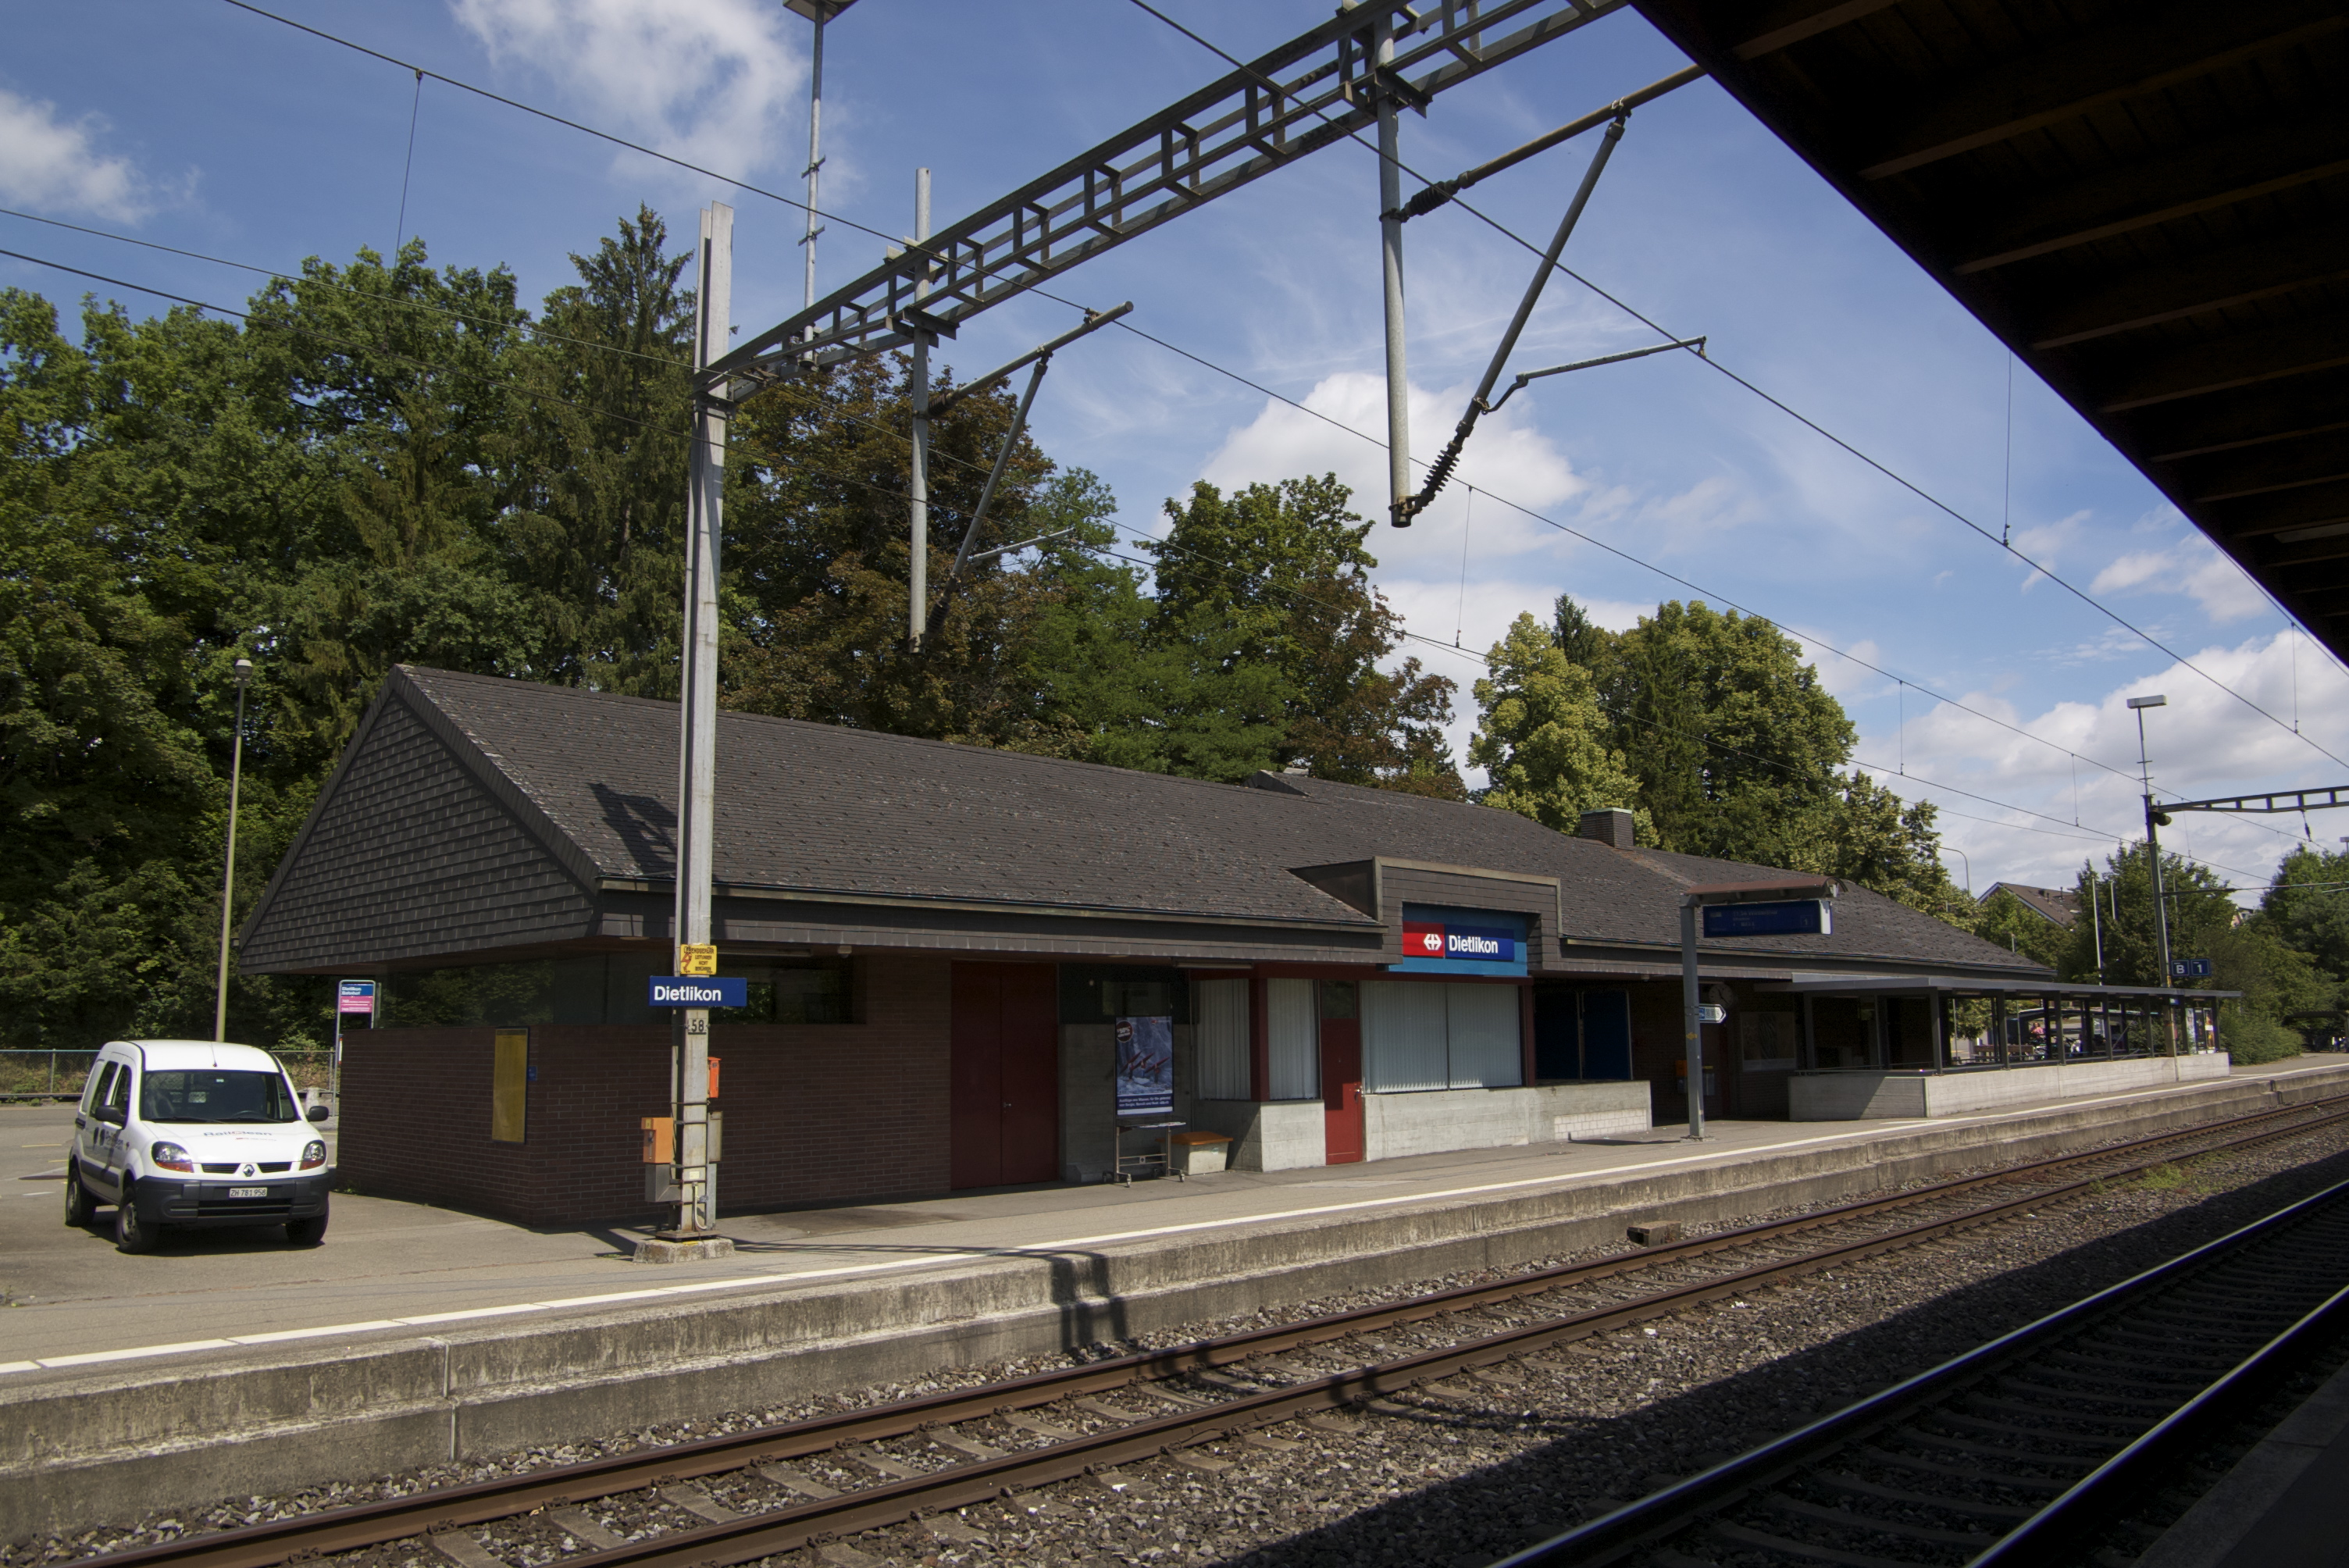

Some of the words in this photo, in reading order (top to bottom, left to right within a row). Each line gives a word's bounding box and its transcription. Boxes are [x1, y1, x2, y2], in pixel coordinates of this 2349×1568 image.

[1449, 935, 1499, 953] Dietlikon
[2176, 964, 2185, 974] B
[2197, 964, 2202, 973] 1
[654, 985, 722, 1001] Dietlikon
[691, 1019, 704, 1032] 58
